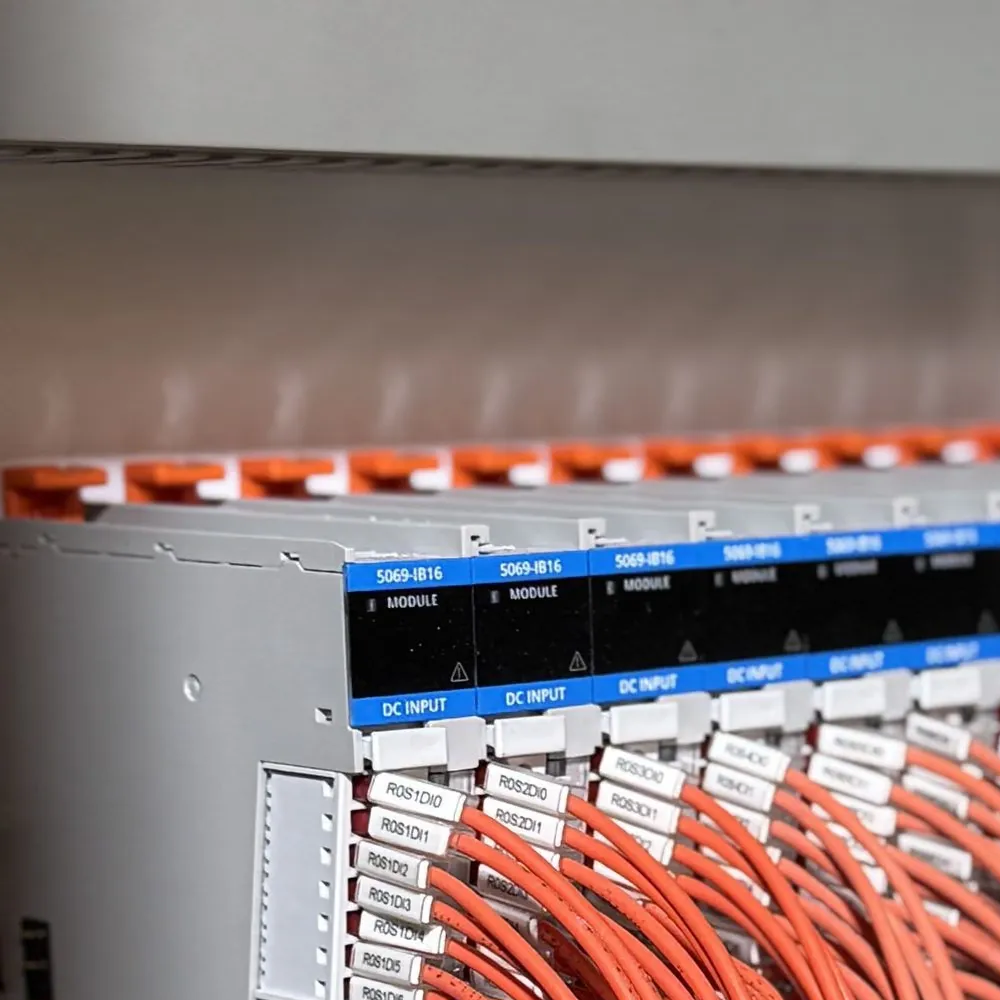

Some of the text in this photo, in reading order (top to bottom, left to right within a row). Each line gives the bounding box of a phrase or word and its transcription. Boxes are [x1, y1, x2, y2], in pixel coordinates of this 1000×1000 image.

[376, 565, 444, 584] 5069-IB16
[500, 558, 563, 577] 5069-IB16
[387, 594, 438, 609] MODULE
[510, 585, 558, 600] MODULE
[619, 673, 679, 694] DC INPUT
[506, 687, 567, 706] DC INPUT
[382, 698, 447, 717] DC INPUT
[386, 782, 443, 808] R0S1DI0
[499, 774, 547, 801] R0S2DI0
[381, 817, 429, 843] R0S1DI1
[495, 808, 542, 834] R0S2DI1
[368, 852, 409, 877] R0S1DI2
[368, 887, 412, 911] R0S1DI3
[362, 952, 401, 973] R0S1DI5
